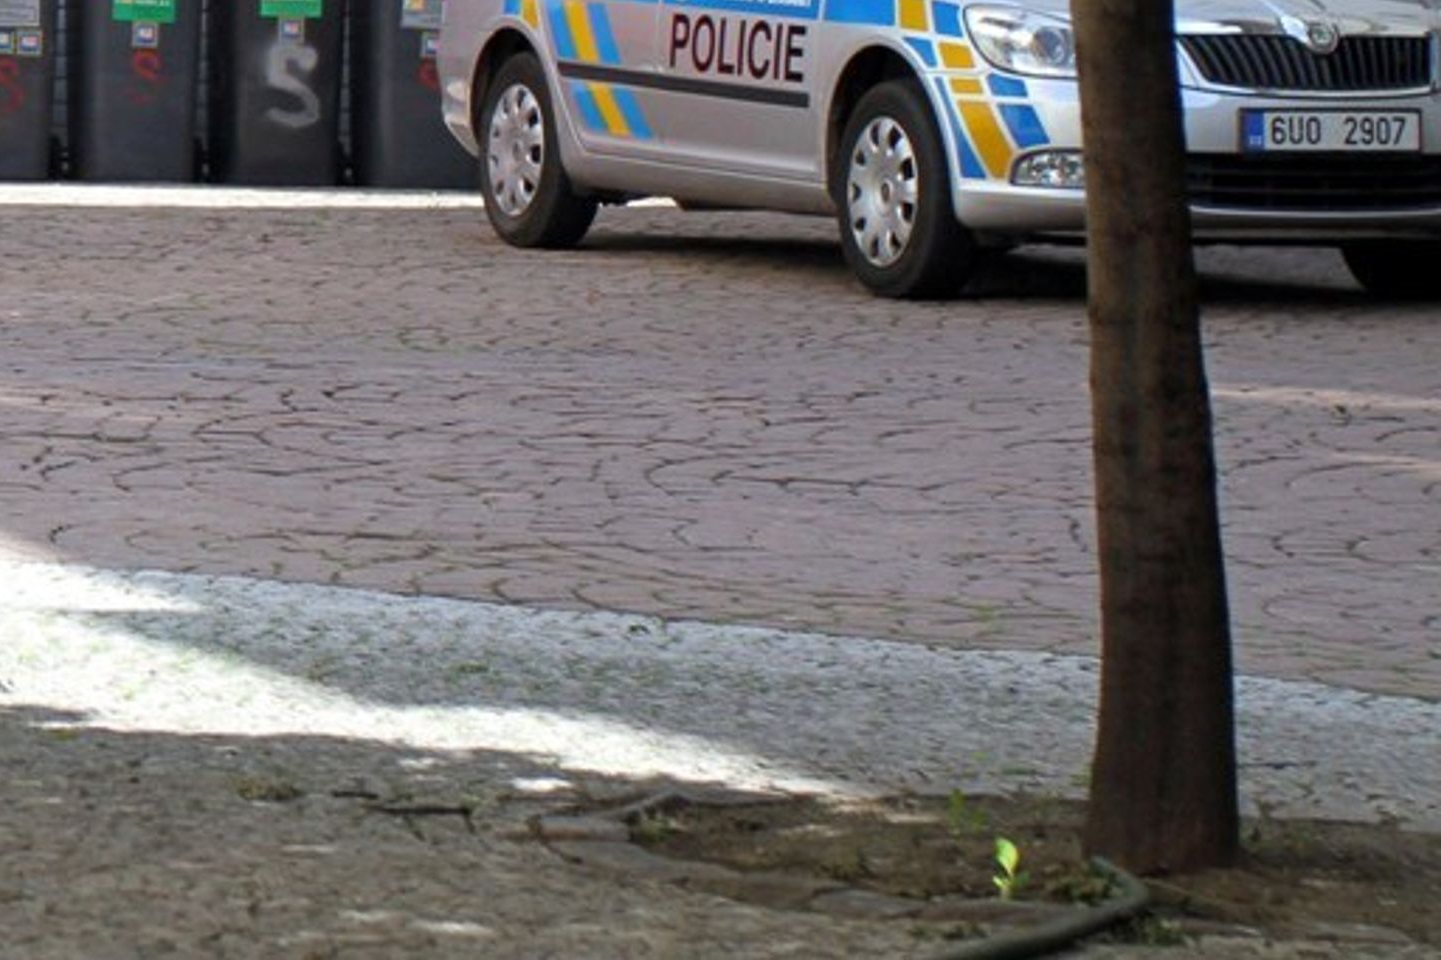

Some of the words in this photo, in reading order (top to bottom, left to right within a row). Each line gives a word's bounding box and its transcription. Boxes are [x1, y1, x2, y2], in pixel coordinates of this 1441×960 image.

[669, 12, 807, 83] POLICIE
[266, 39, 320, 128] S
[1343, 117, 1407, 145] 2907
